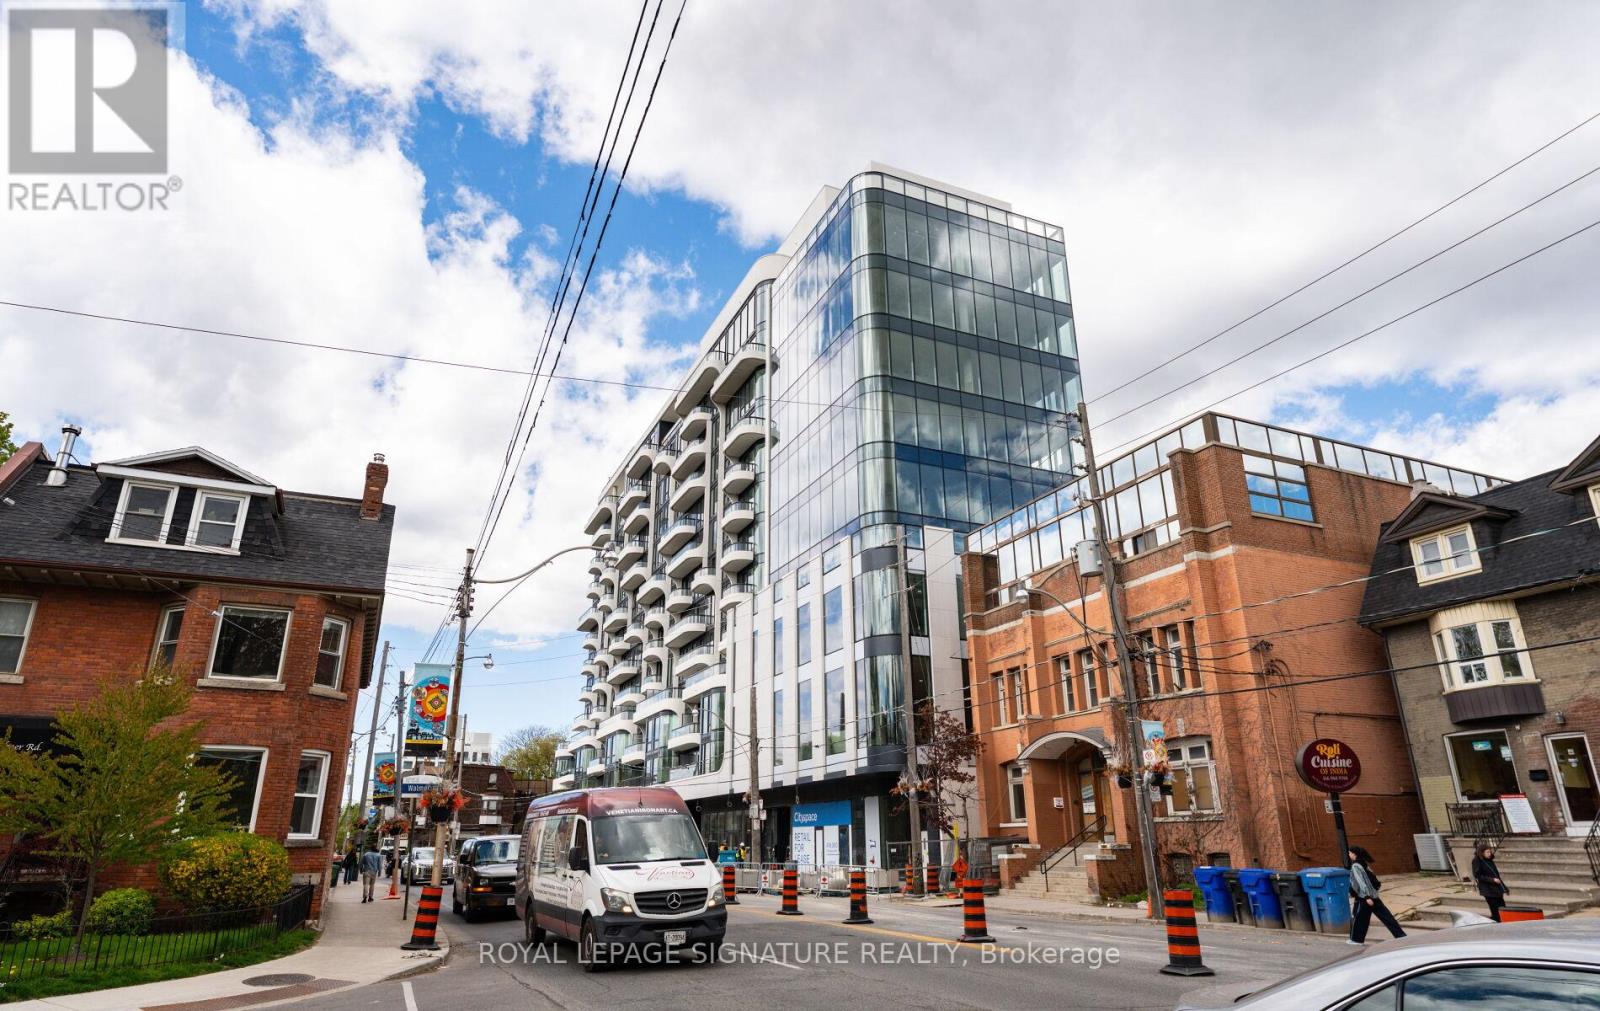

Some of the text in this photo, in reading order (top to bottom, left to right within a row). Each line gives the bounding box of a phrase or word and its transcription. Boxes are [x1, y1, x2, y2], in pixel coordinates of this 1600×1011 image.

[1311, 755, 1353, 768] Cuisine
[794, 812, 817, 823] Cityspace
[794, 843, 804, 852] FOR
